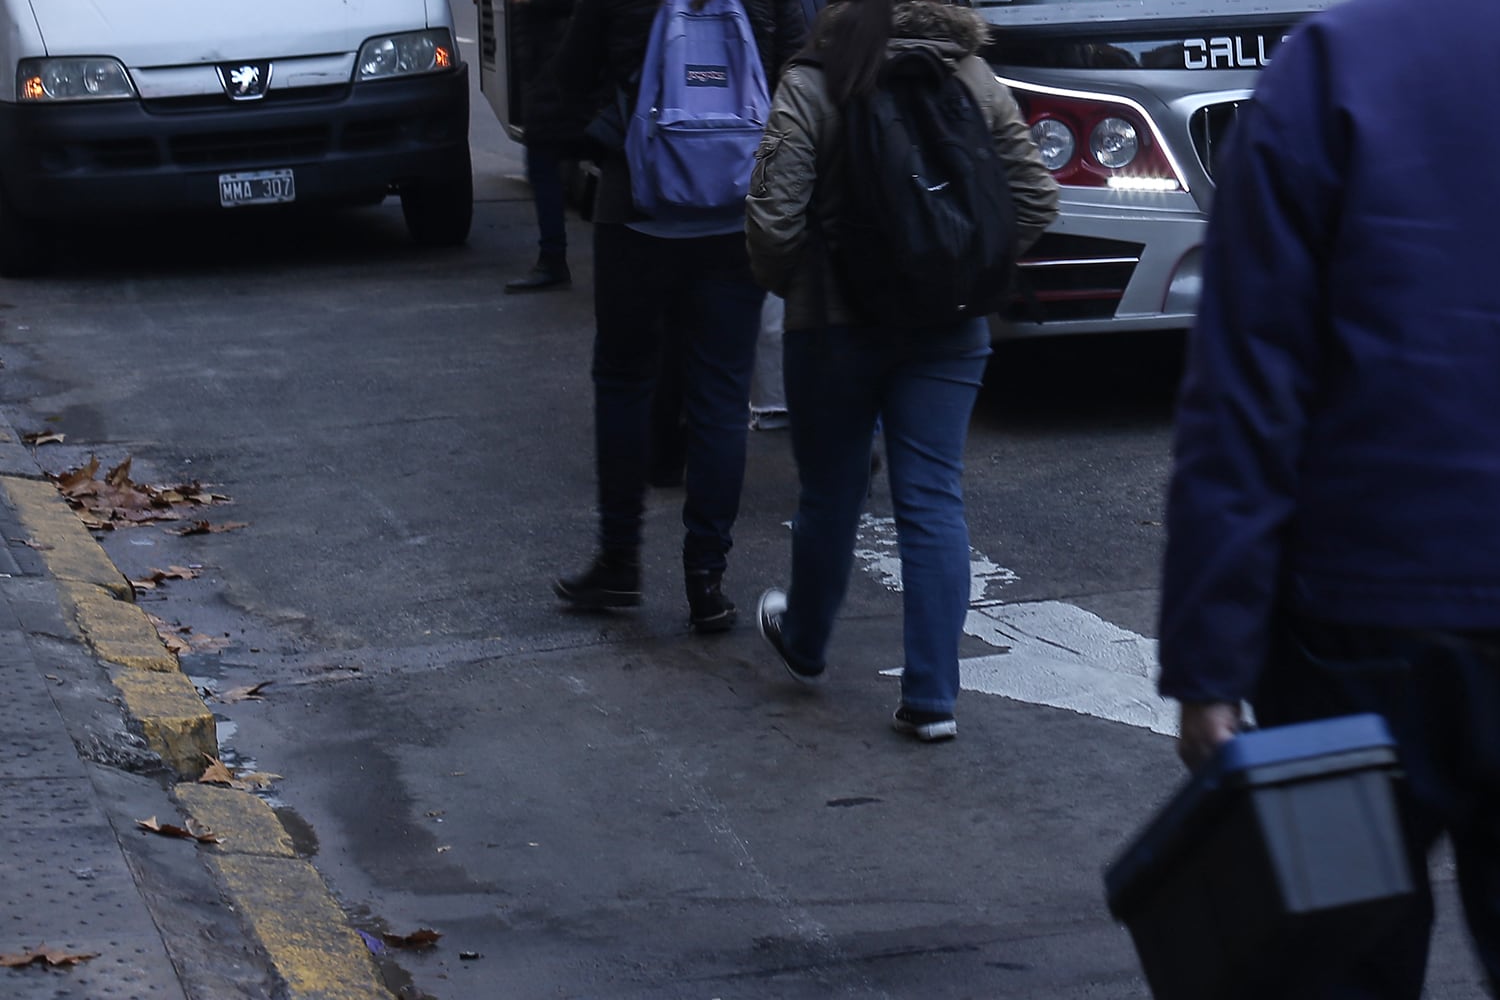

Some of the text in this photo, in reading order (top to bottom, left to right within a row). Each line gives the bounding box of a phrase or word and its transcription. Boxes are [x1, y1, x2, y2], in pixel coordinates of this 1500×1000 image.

[1184, 35, 1292, 69] CALL
[223, 177, 290, 201] MMA 307
